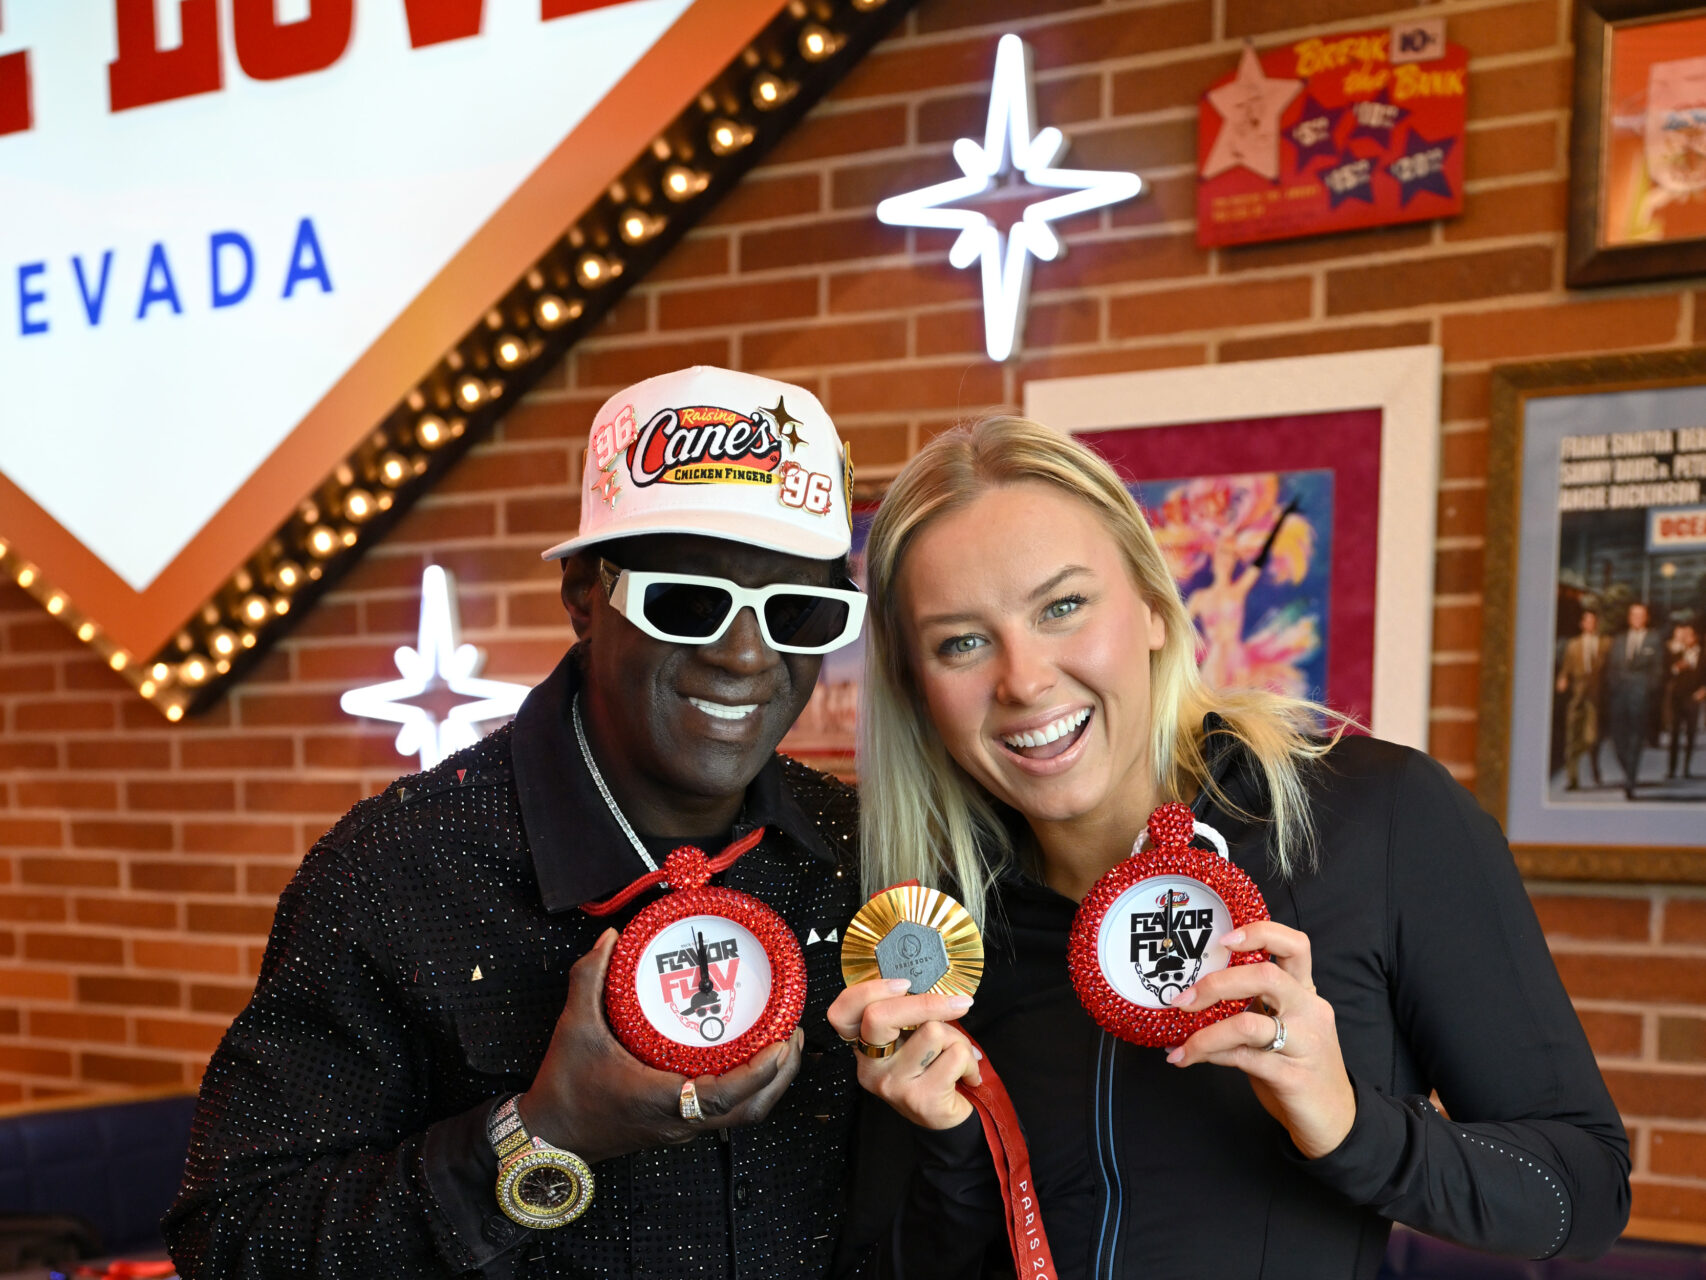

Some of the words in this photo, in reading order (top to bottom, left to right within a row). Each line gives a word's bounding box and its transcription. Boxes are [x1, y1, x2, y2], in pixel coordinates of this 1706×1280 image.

[595, 406, 634, 470] 96
[681, 407, 737, 426] Raising
[631, 408, 781, 487] Cane's
[675, 468, 722, 481] CHICKEN
[725, 468, 773, 484] FINGERS
[781, 463, 831, 514] 96
[1131, 909, 1213, 933] FLAVOR
[1019, 1180, 1040, 1250] PARIS
